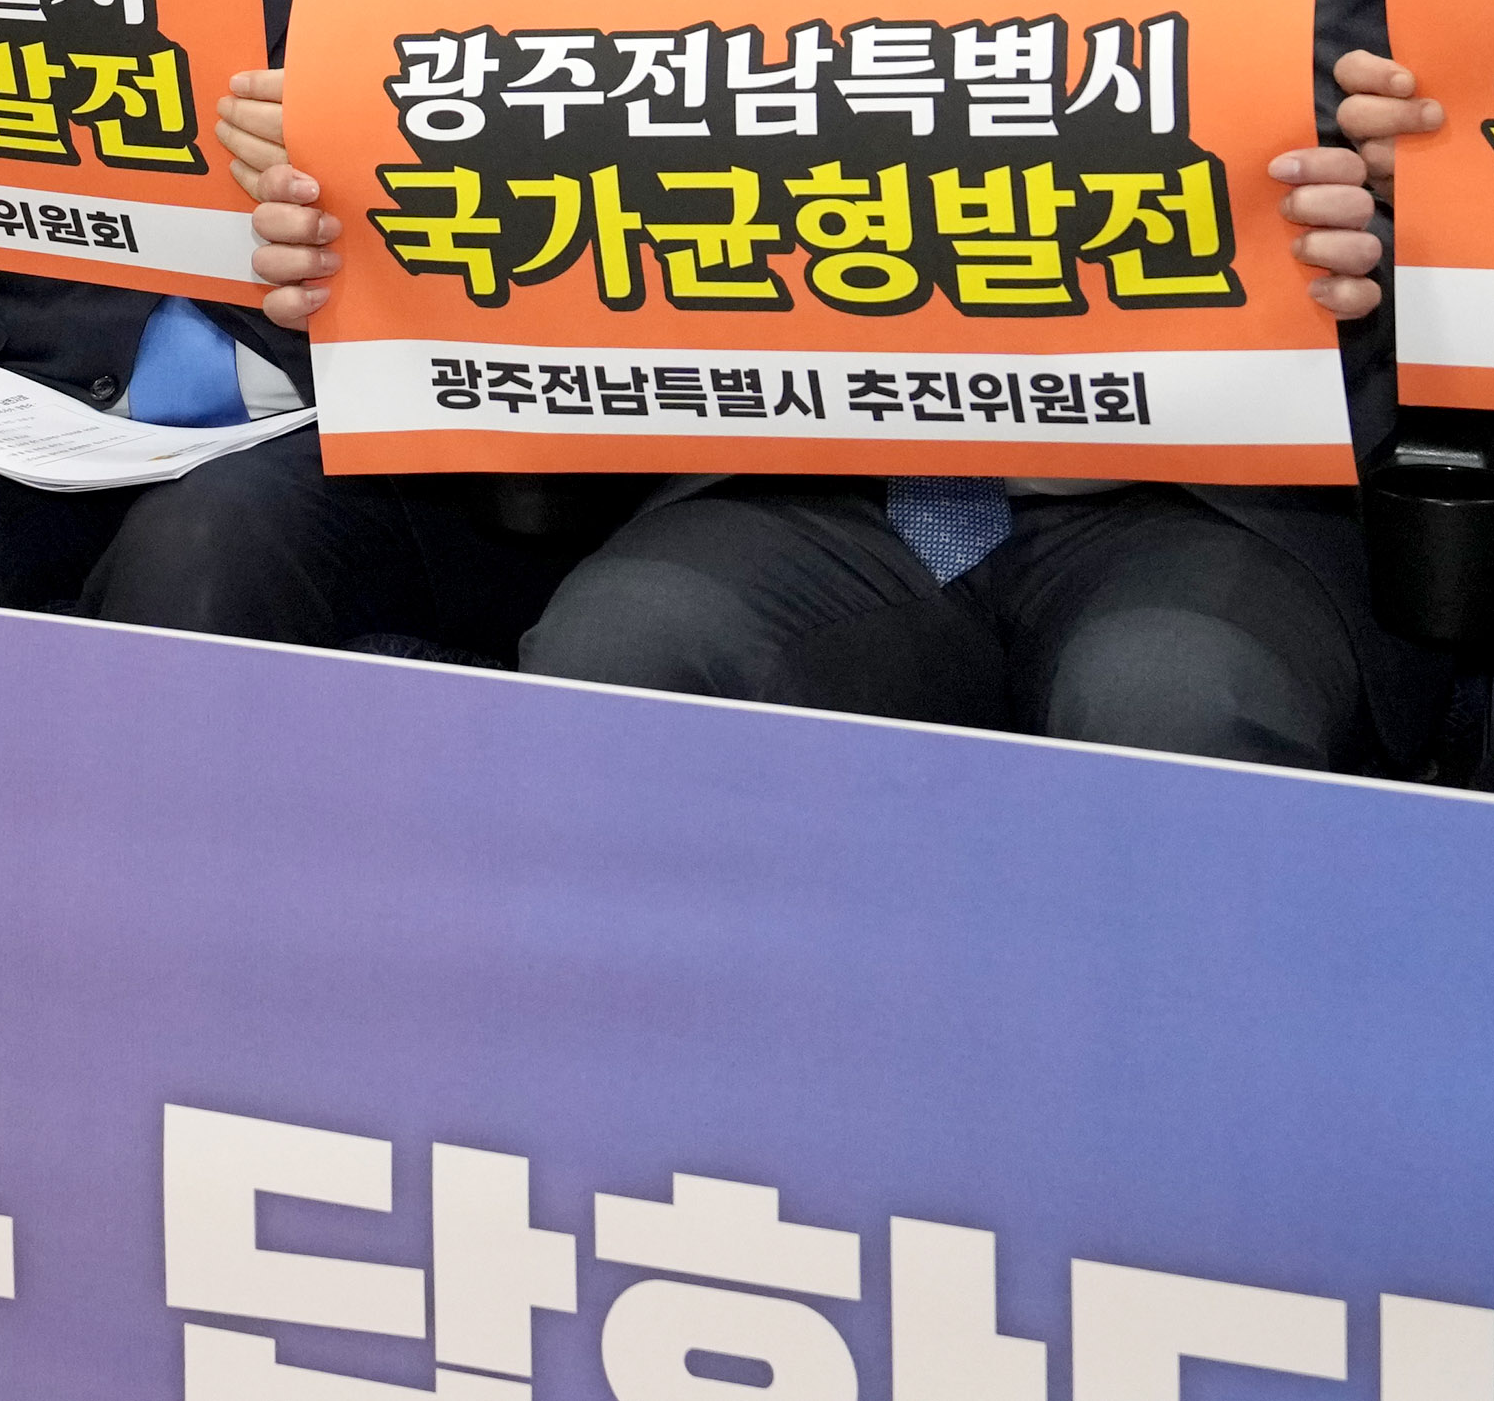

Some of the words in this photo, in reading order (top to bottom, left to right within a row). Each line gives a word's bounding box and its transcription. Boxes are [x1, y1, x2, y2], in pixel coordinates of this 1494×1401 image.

[390, 18, 1176, 142] 광주전남특별시
[382, 159, 1231, 305] 국가균형발전
[430, 357, 826, 424] 광주전남특별시
[846, 369, 1152, 427] 추진위원회
